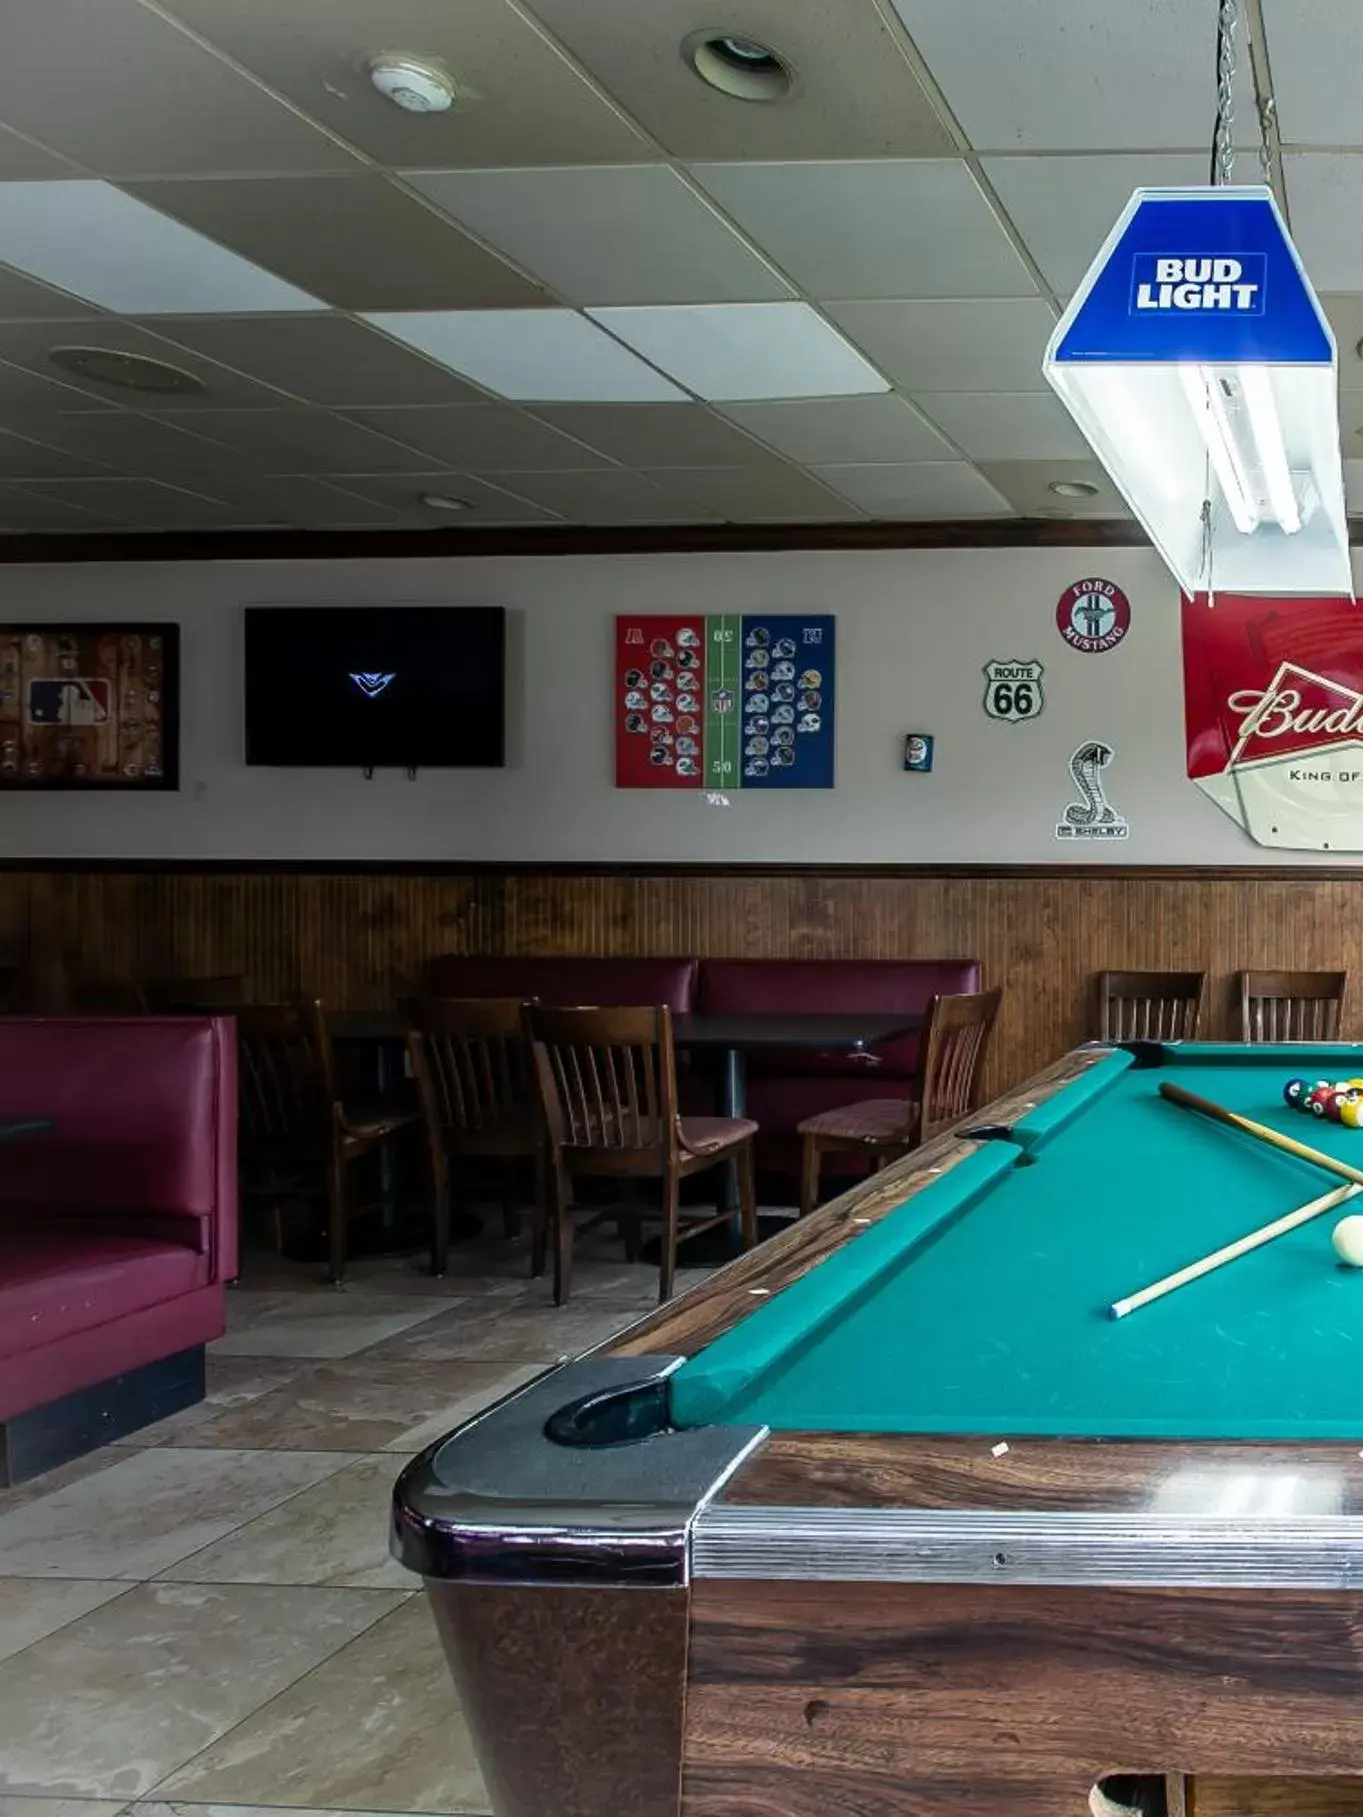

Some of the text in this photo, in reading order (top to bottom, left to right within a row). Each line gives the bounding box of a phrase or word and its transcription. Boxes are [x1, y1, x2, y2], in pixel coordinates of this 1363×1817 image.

[1155, 259, 1242, 283] BUD
[1136, 284, 1258, 309] LIGHT
[1072, 580, 1116, 597] FORD
[1062, 626, 1124, 651] MUSTANG
[993, 667, 1034, 679] ROUTE
[993, 683, 1034, 715] 66
[712, 761, 732, 774] 50
[1289, 770, 1332, 783] KING
[1339, 771, 1361, 783] OF
